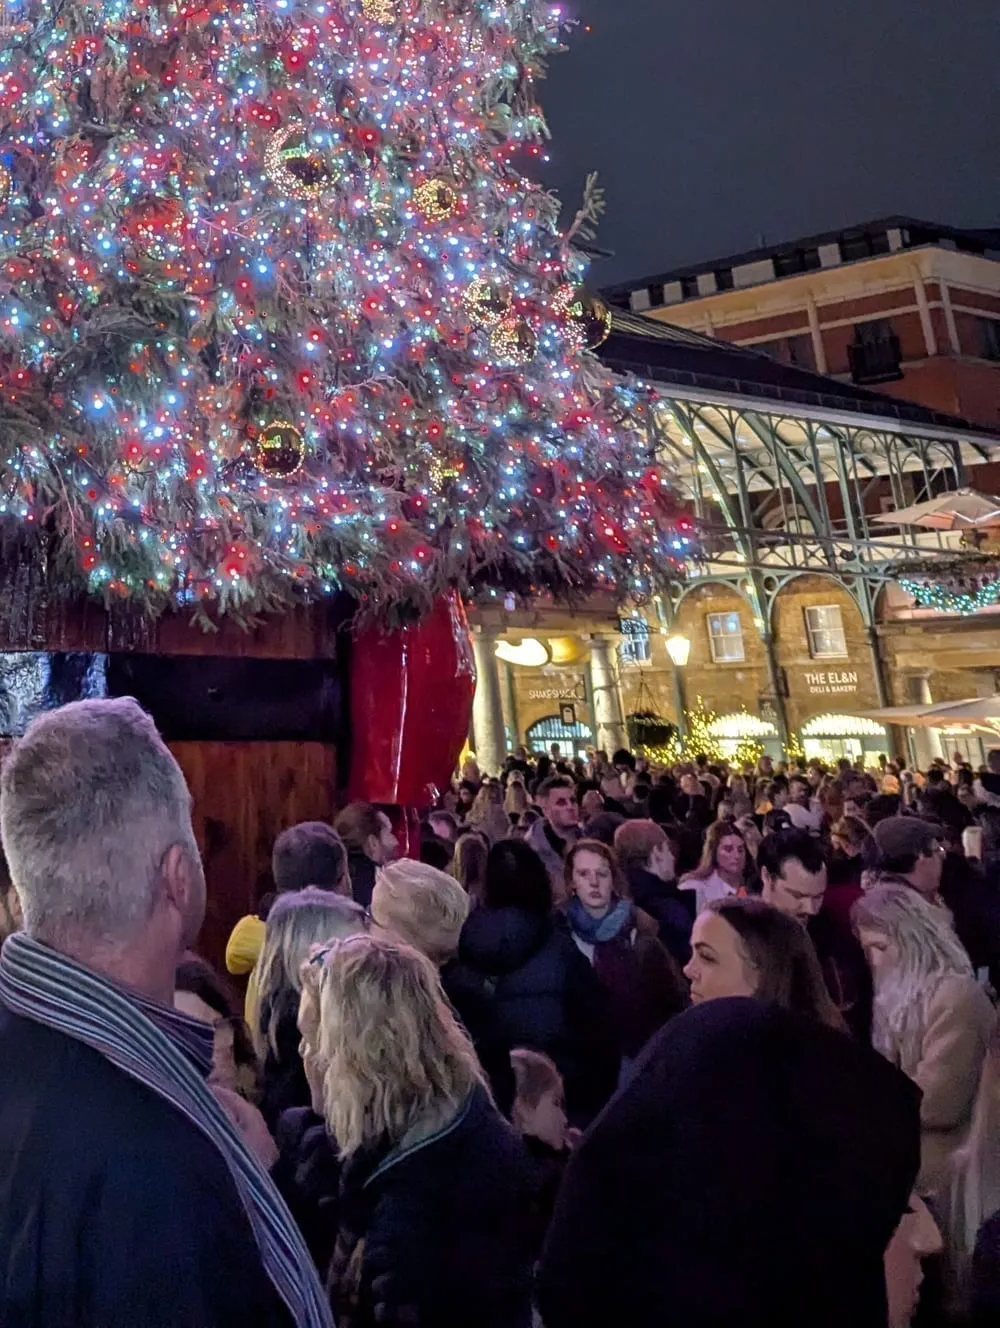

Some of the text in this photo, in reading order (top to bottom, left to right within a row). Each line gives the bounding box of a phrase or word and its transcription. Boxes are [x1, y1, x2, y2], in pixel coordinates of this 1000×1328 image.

[804, 671, 858, 685] THE EL&N
[809, 685, 857, 693] DELI & BAKERY
